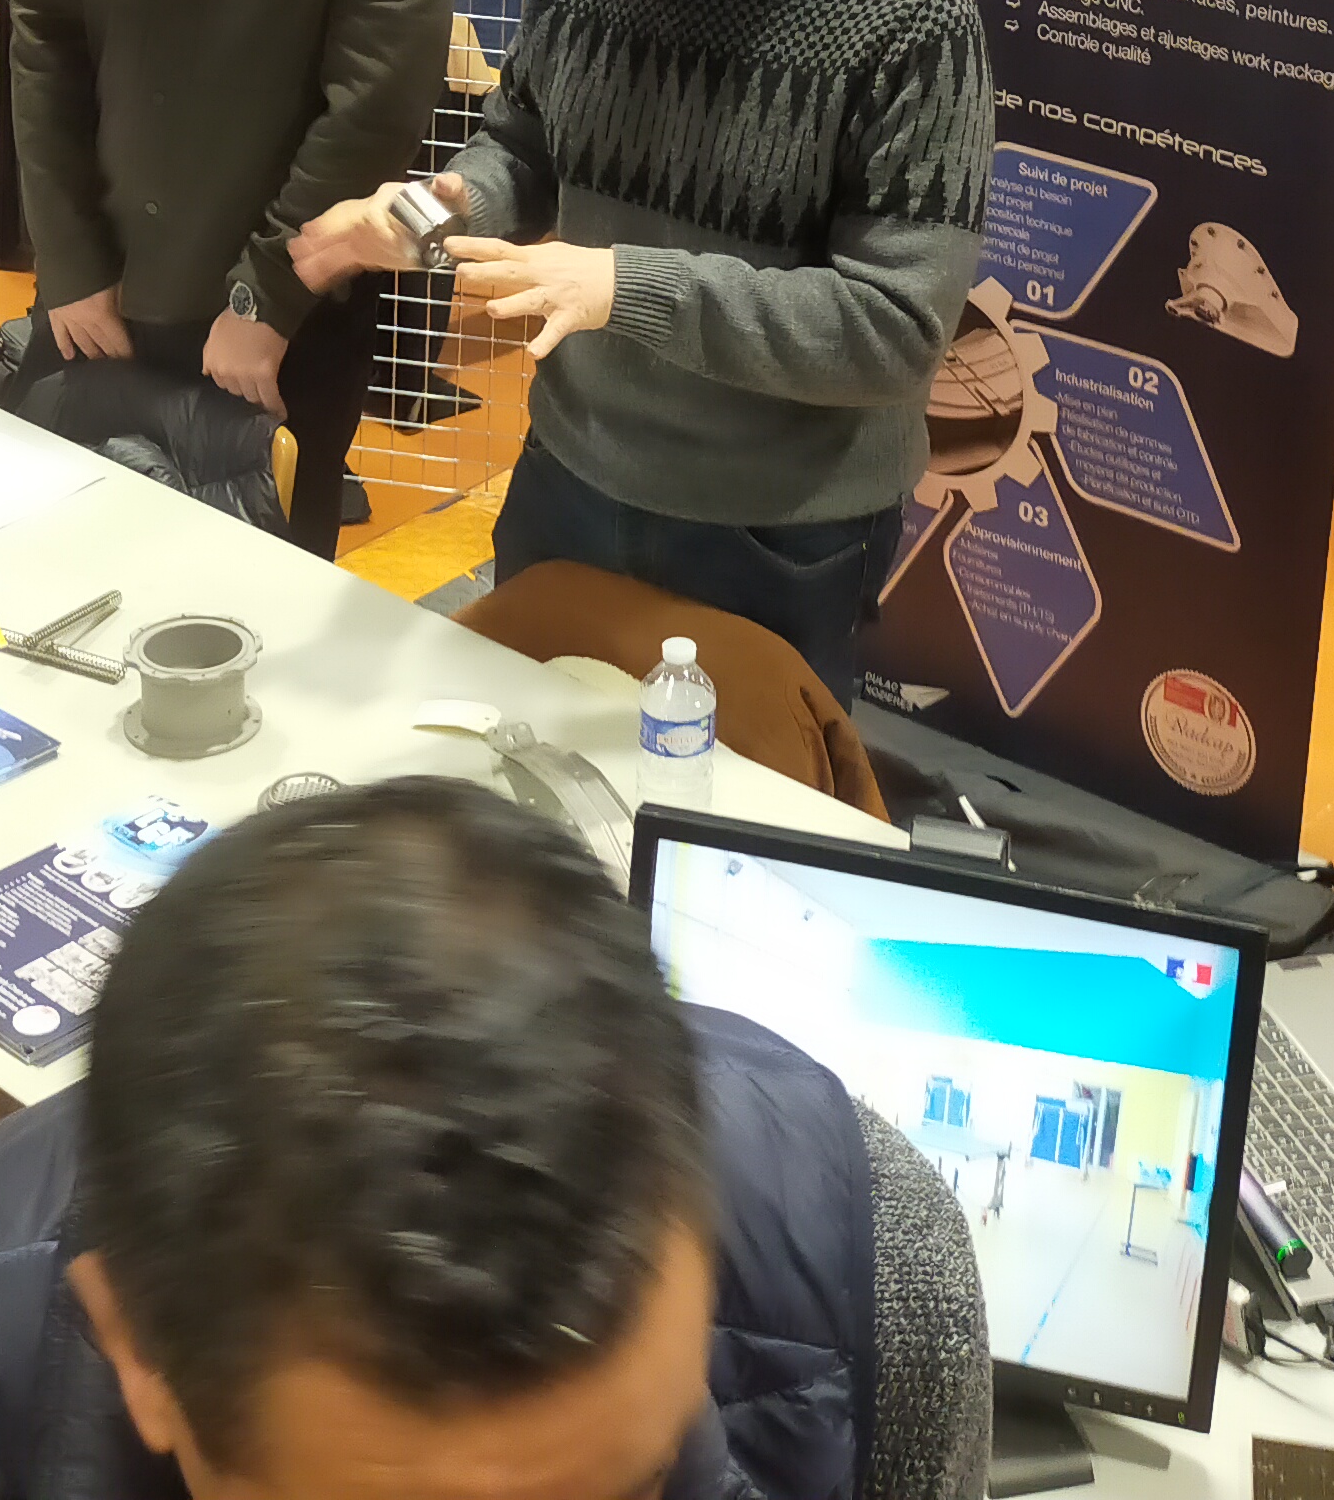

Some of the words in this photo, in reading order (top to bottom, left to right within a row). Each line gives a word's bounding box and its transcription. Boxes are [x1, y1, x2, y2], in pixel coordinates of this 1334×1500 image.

[1038, 0, 1137, 39] Assemblages
[1140, 24, 1155, 42] et
[1157, 30, 1228, 61] ajustages
[1232, 49, 1271, 72] work
[1245, 2, 1333, 35] peintures.
[1037, 23, 1099, 52] Contrôle
[1103, 40, 1151, 66] qualité
[1028, 100, 1077, 124] nos
[1083, 111, 1268, 177] compétences
[1018, 161, 1049, 182] Suivi
[1051, 171, 1067, 187] de
[1070, 178, 1108, 198] projet
[986, 206, 1024, 224] position
[1026, 280, 1055, 307] 01
[1055, 367, 1154, 412] Industrialisation
[1128, 366, 1159, 395] 02
[1018, 501, 1049, 528] 03
